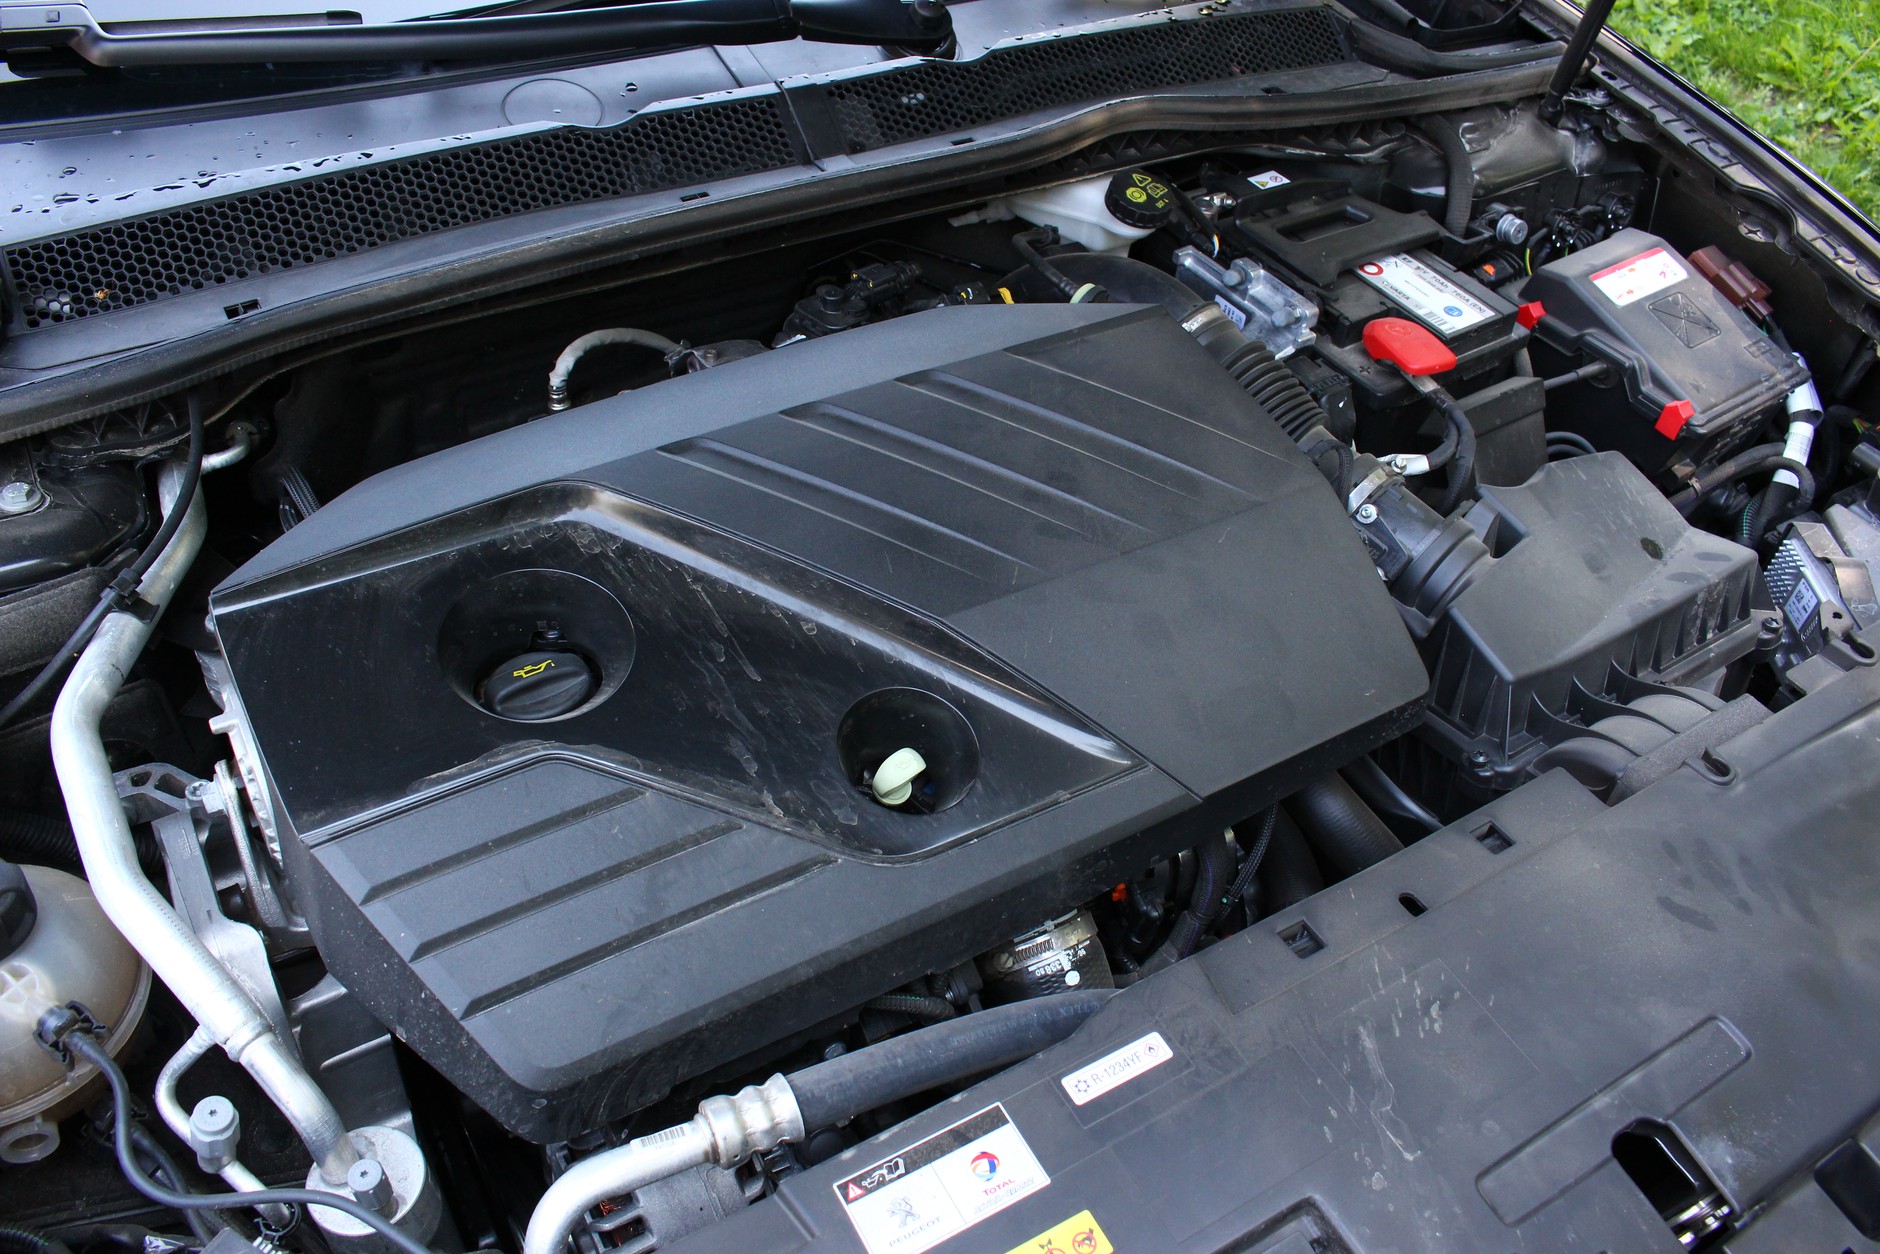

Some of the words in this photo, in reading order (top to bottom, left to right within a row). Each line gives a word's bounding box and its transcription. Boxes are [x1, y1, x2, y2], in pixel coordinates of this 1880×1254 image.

[1431, 275, 1449, 289] 70Ah
[1470, 302, 1486, 314] (EN)
[1090, 1050, 1142, 1085] R-1234YF
[982, 1178, 1016, 1197] TOTAL
[888, 1216, 941, 1247] PEUGEOT
